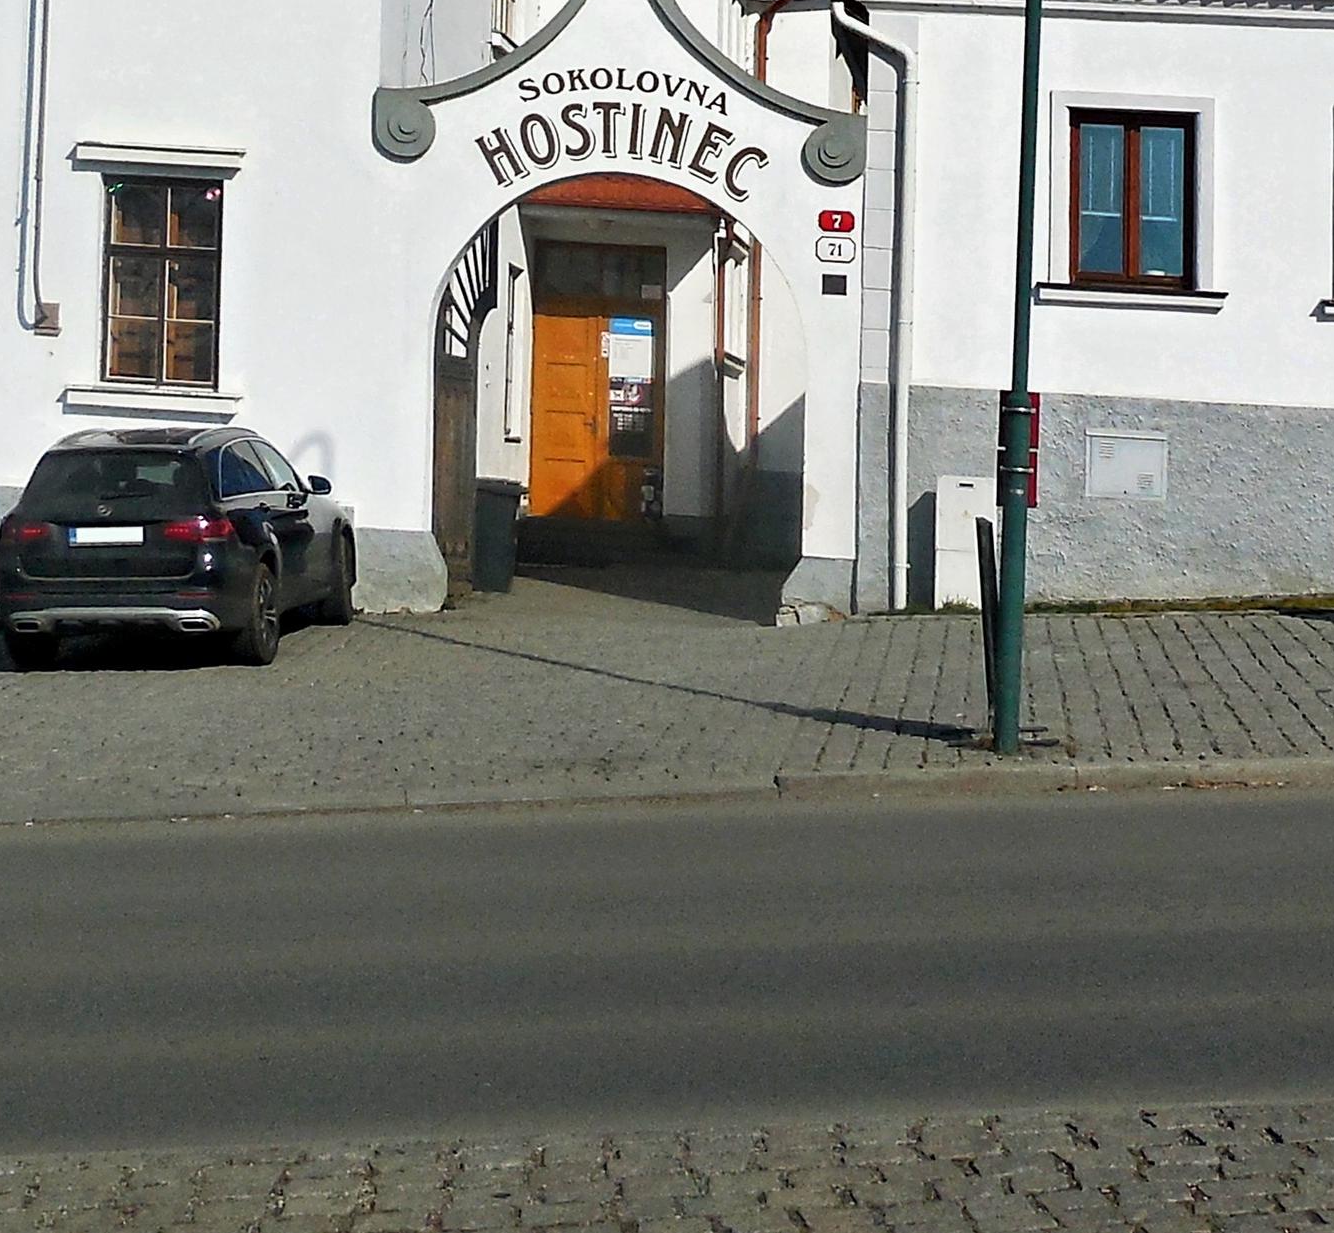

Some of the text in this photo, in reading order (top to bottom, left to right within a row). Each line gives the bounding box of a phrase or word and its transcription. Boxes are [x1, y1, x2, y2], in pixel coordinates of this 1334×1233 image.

[518, 68, 729, 116] SOKOLOVNA
[474, 101, 769, 202] HOSTINEC
[831, 215, 842, 229] 7
[827, 243, 843, 256] 71
